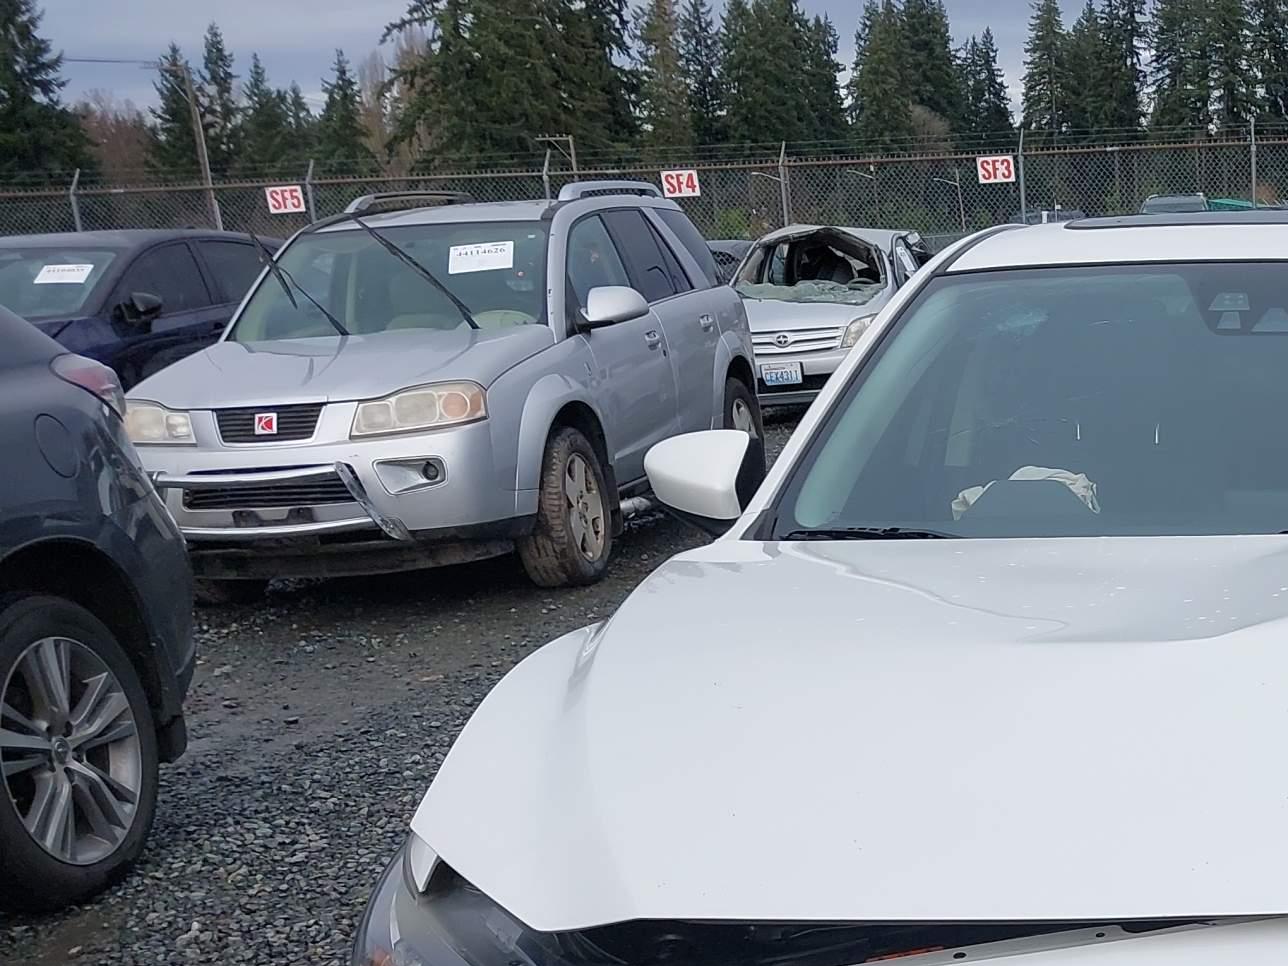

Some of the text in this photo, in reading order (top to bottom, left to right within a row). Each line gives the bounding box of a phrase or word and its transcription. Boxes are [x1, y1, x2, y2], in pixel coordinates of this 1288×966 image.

[980, 158, 1012, 180] SF3
[664, 172, 697, 194] SF4
[269, 188, 301, 210] SF5
